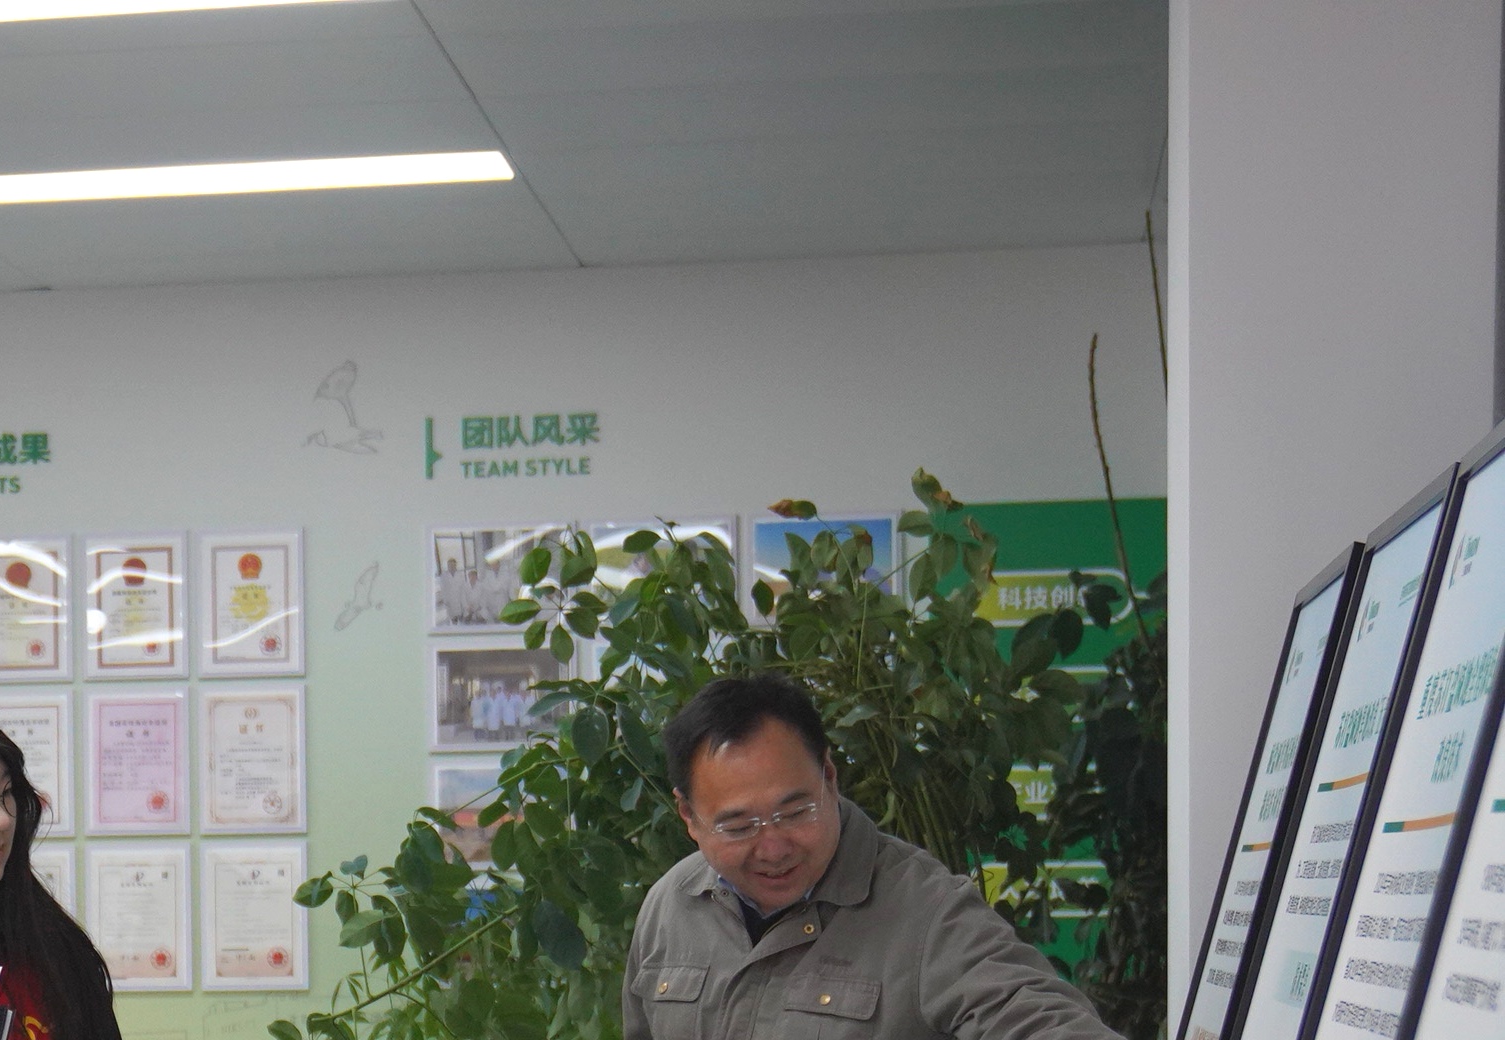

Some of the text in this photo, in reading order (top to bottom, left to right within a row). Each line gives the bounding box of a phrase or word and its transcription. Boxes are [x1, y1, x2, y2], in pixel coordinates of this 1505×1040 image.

[462, 412, 600, 449] 团队风采
[460, 456, 590, 478] TEAM STYLE
